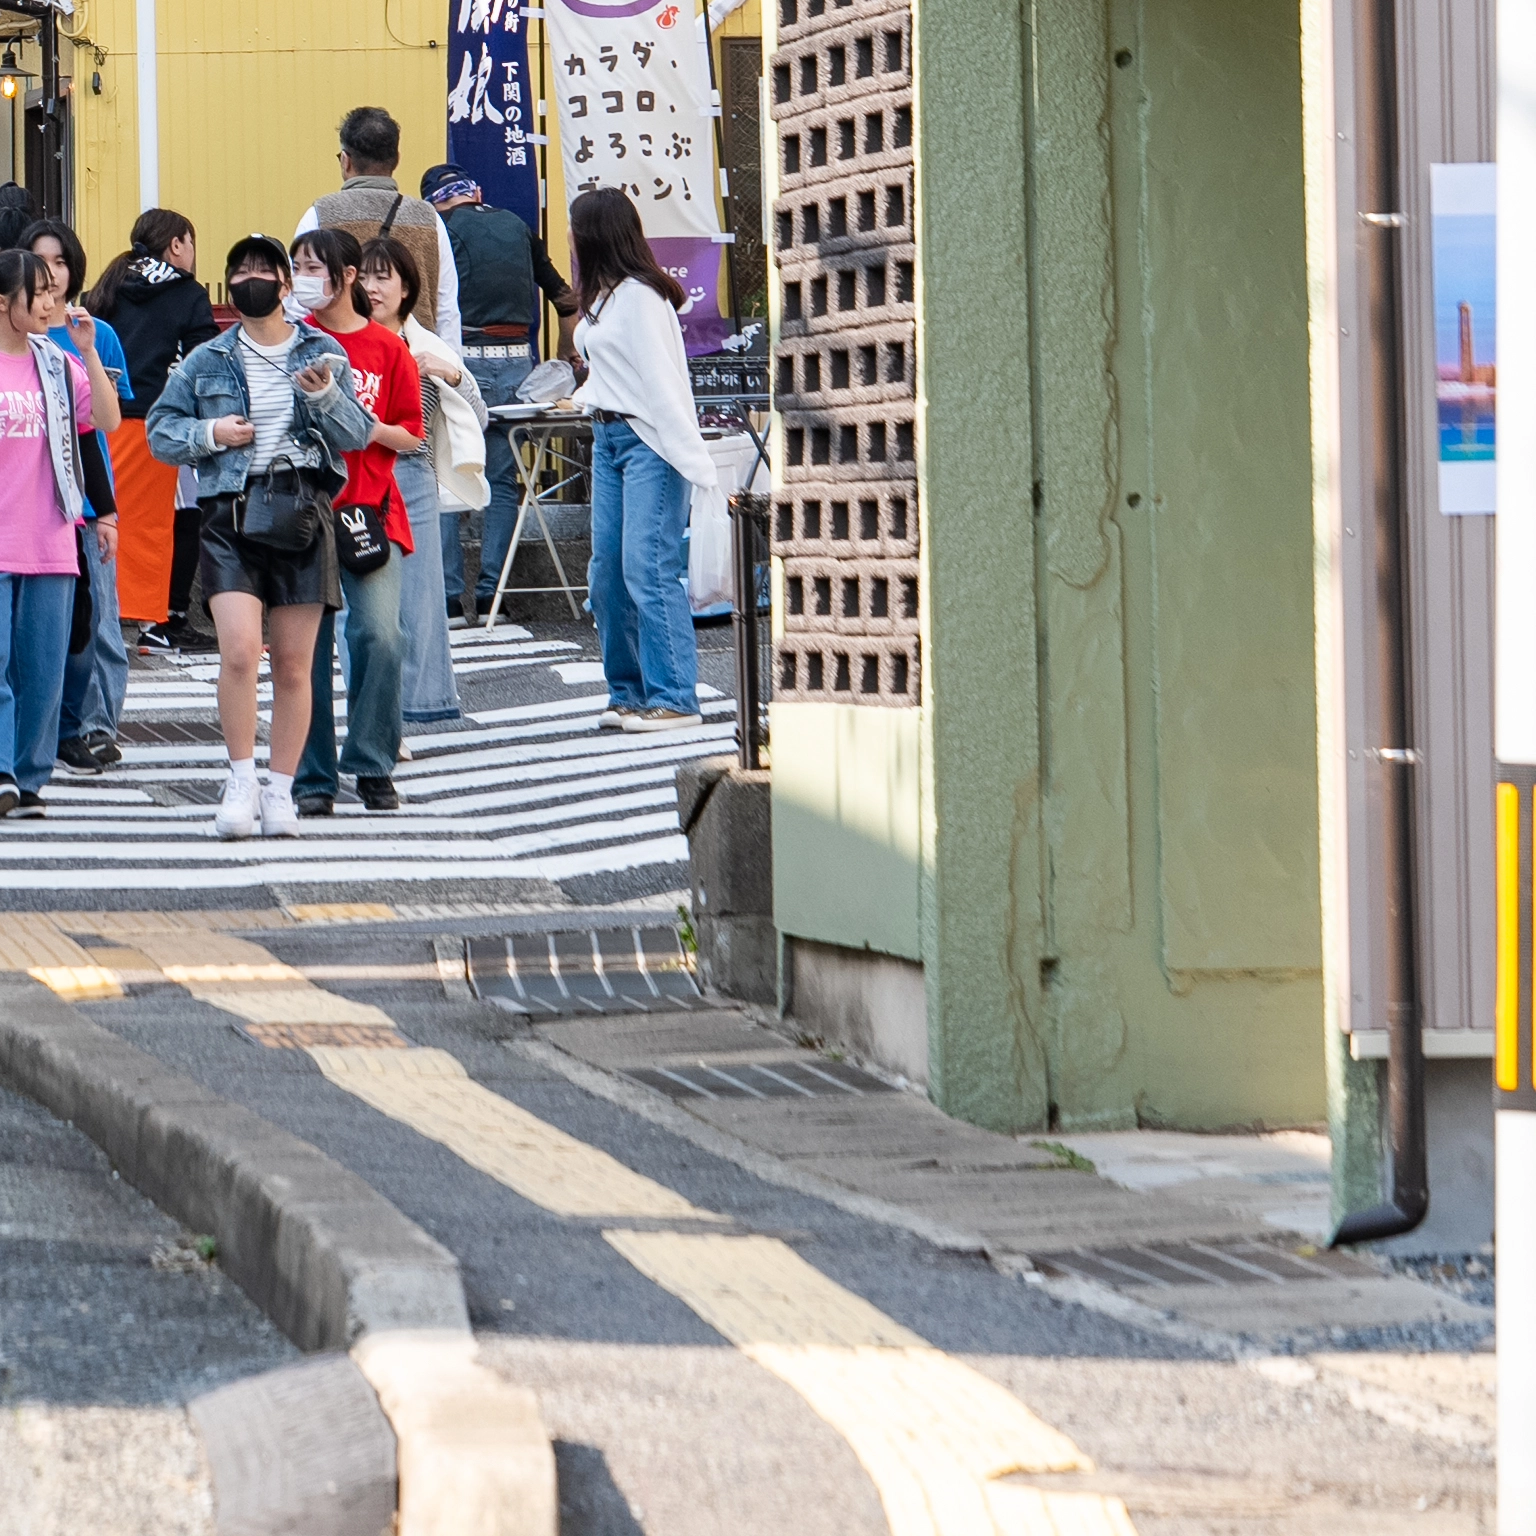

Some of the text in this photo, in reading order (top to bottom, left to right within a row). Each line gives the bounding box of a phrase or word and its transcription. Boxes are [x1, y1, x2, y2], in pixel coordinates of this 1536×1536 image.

[564, 41, 677, 76] カラダ、
[501, 61, 528, 167] 下関の地酒
[568, 90, 675, 118] ココロ、
[575, 132, 691, 163] よろこぶ
